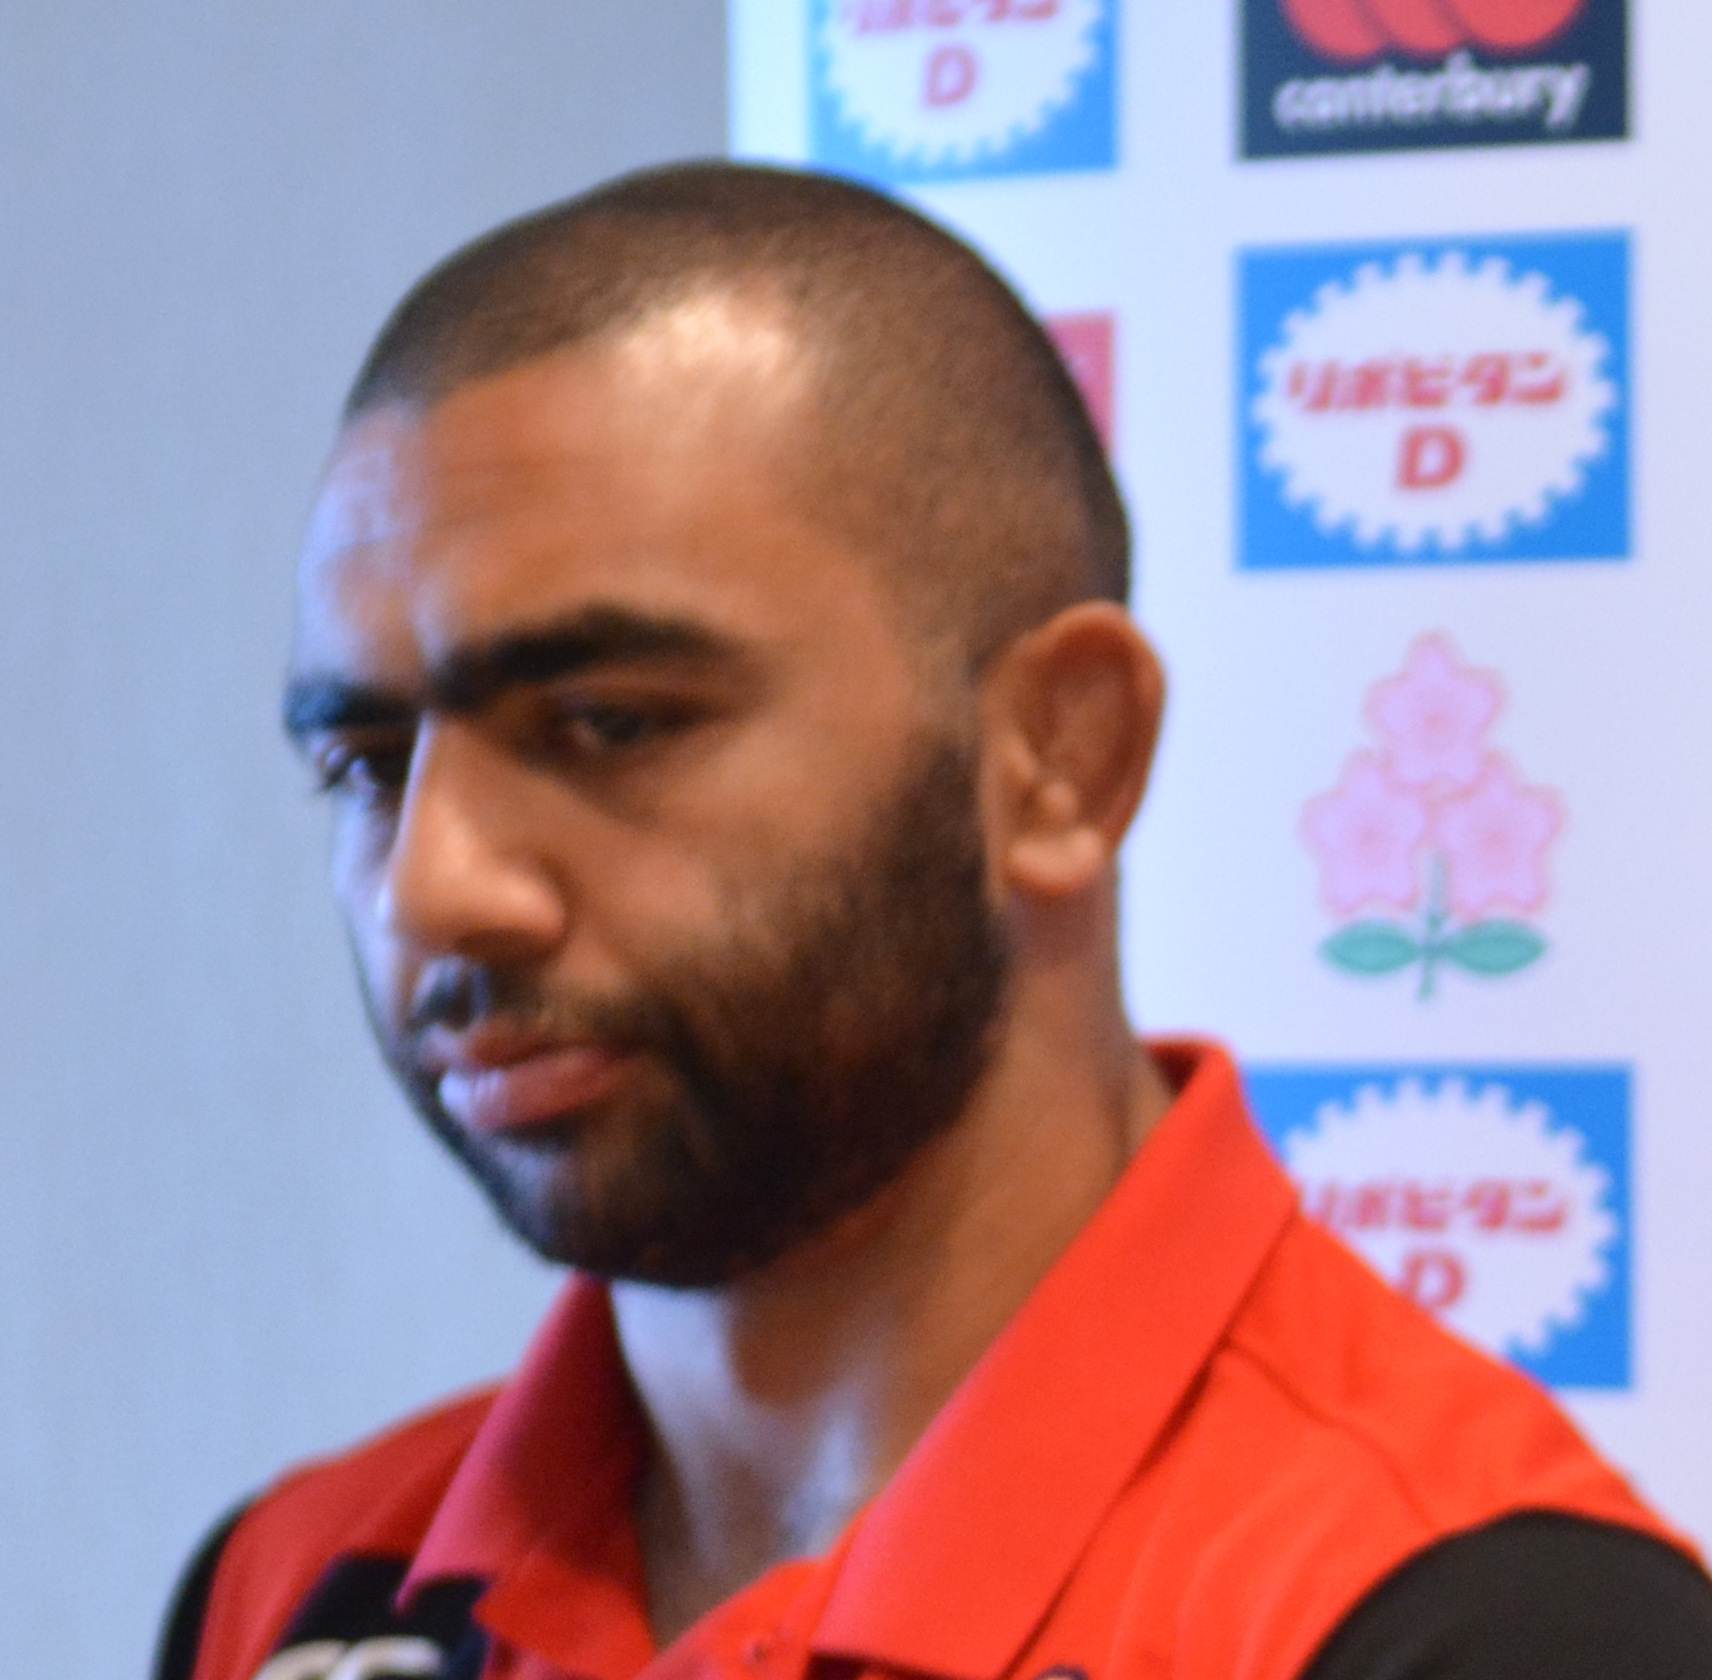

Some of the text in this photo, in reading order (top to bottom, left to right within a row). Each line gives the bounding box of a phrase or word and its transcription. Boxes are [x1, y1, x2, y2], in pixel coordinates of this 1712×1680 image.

[923, 43, 979, 108] D
[1275, 54, 1588, 126] canterbury
[1290, 348, 1568, 414] リポビタン
[1397, 425, 1467, 492] D
[1400, 1248, 1467, 1312] D
